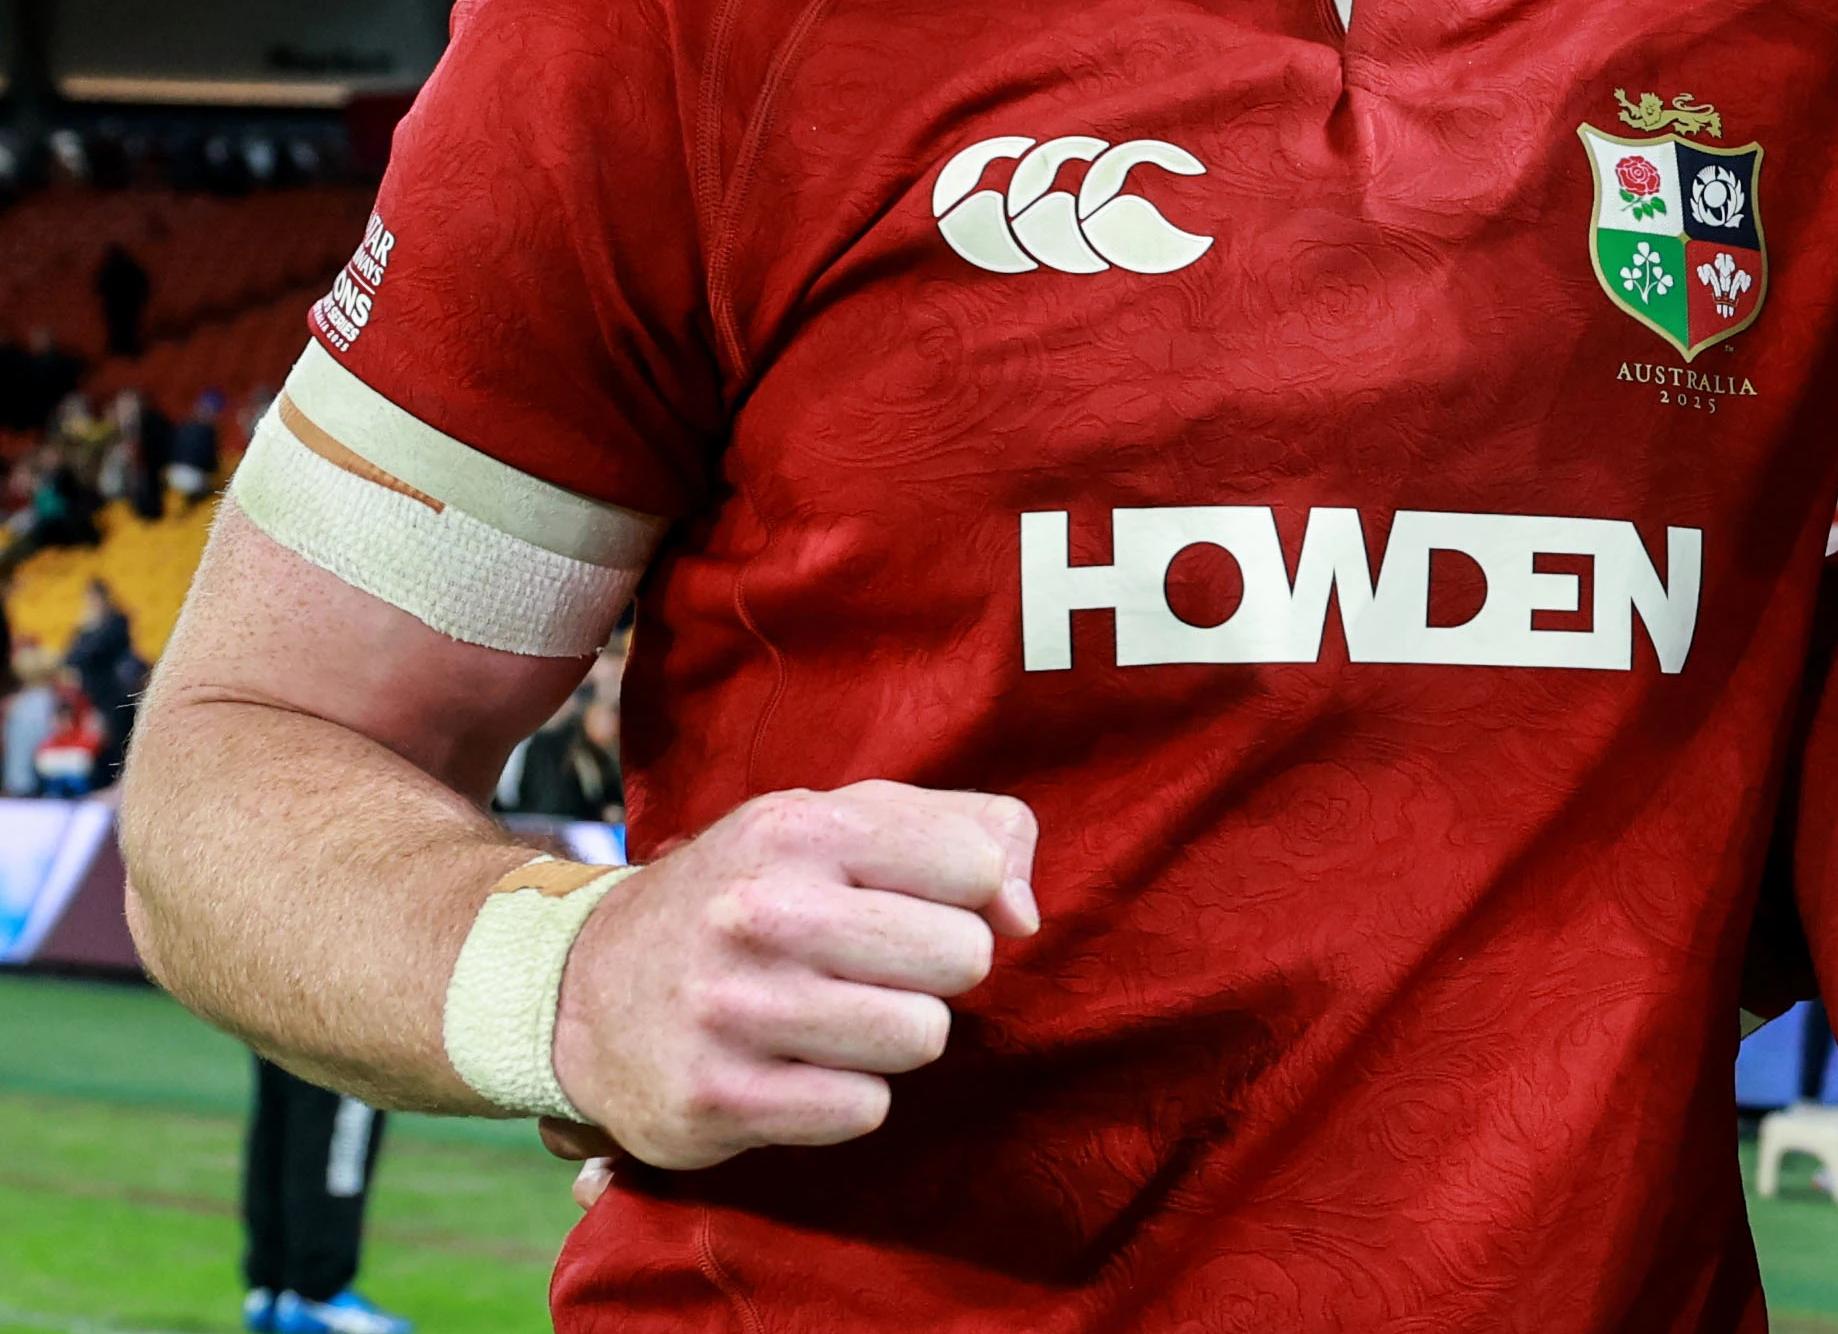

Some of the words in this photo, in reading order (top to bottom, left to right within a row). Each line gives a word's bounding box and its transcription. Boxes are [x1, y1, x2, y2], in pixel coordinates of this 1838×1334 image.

[334, 270, 372, 327] ONS
[327, 306, 360, 342] SERIES
[1617, 362, 1757, 395] AUSTRALIA
[1660, 390, 1716, 414] 2025
[1020, 507, 1703, 674] HOWDEN
